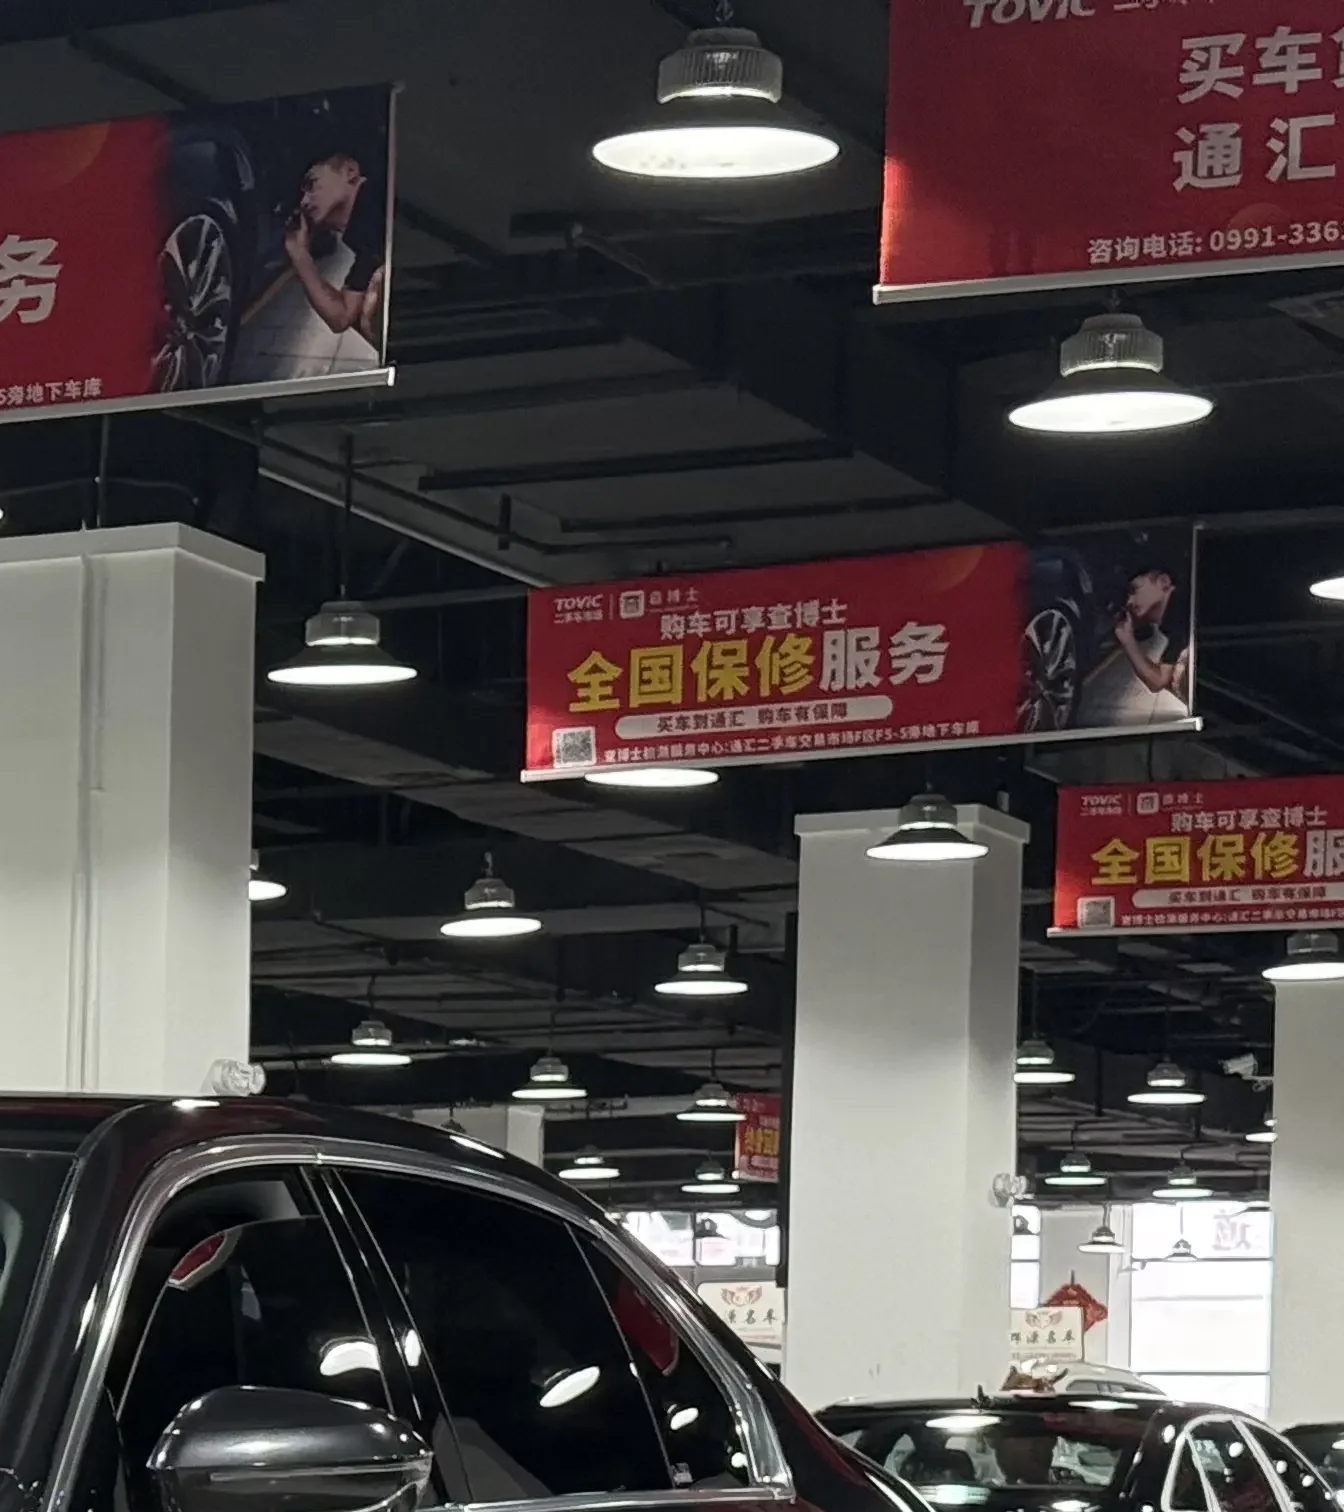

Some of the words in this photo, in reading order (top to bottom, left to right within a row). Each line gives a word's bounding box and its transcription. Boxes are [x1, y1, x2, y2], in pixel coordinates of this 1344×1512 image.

[1177, 25, 1344, 104] 买车
[1172, 113, 1336, 192] 通汇
[1209, 220, 1344, 252] 0991-336
[660, 598, 848, 640] 购车可享查博士
[567, 621, 950, 713] 全国保修服务
[1170, 805, 1328, 833] 购车可享查博士
[1090, 829, 1344, 886] 全国保修服
